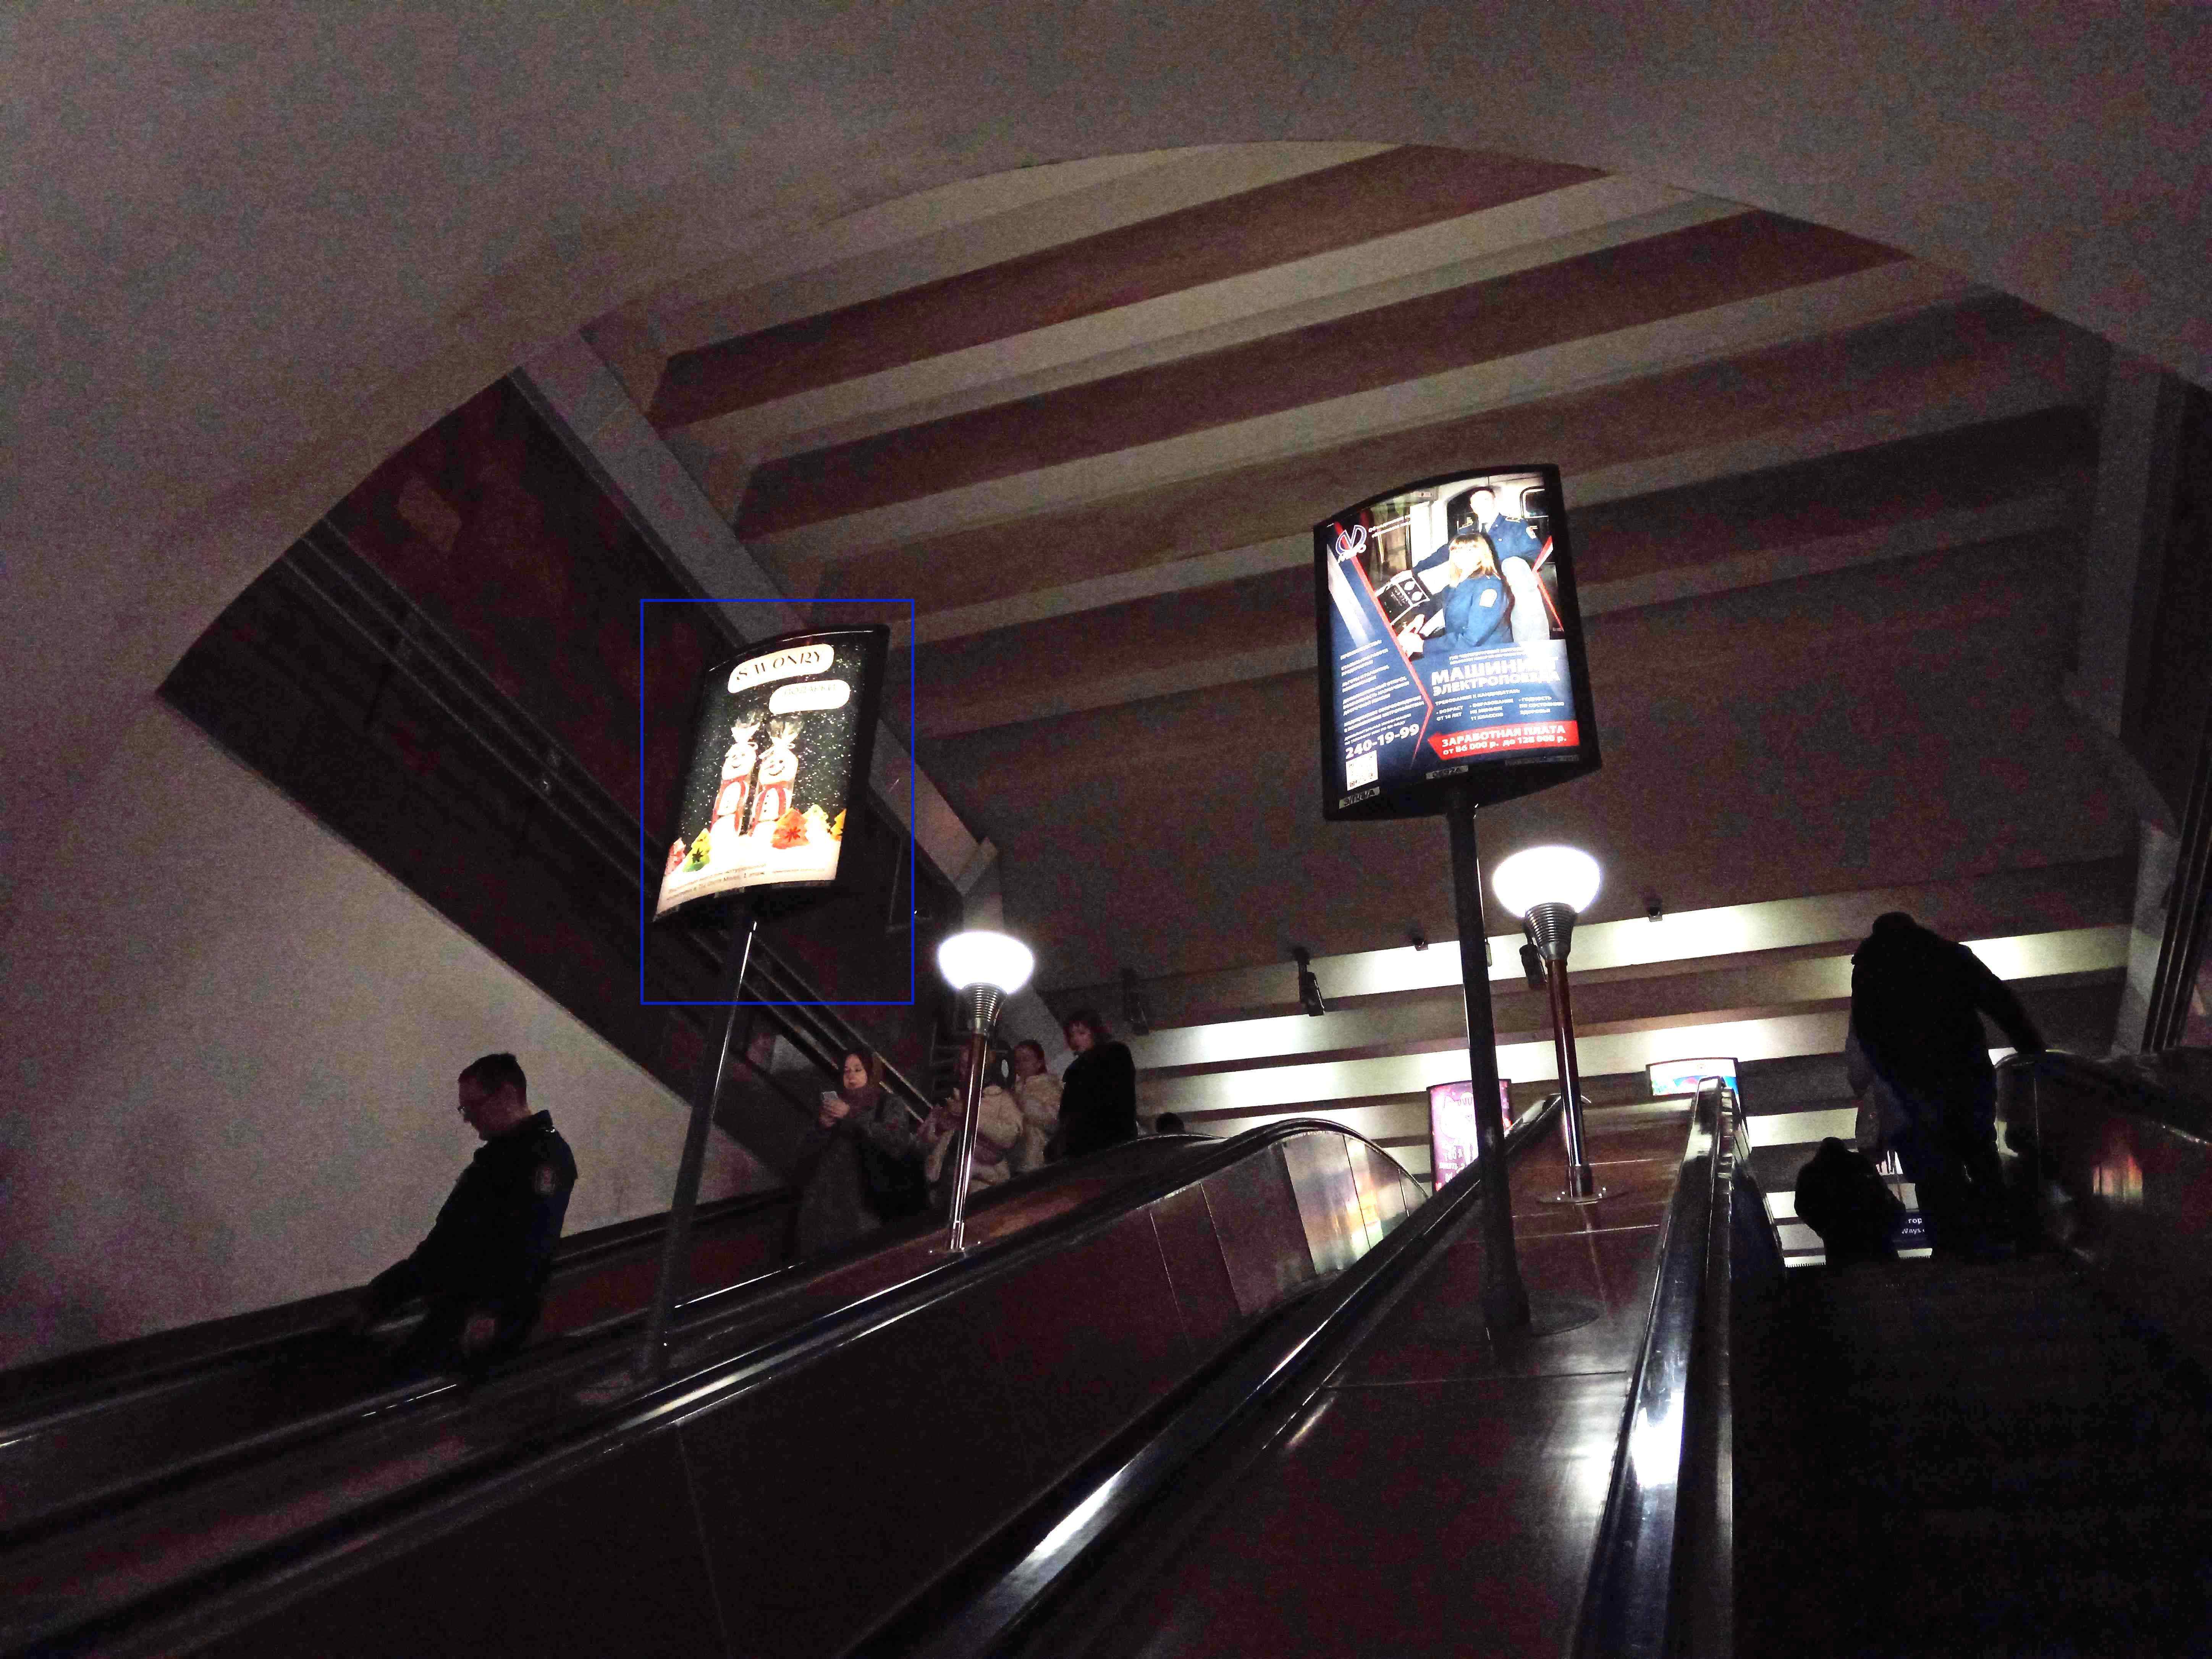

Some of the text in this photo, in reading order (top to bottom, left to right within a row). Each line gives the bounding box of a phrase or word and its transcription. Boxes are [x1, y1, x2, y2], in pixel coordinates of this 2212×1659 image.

[1431, 656, 1559, 685] МАШИНИТ
[1433, 671, 1561, 696] ЭЛЕКТРОПОЕДА
[1345, 724, 1420, 759] 240-19-99
[1442, 725, 1566, 747] ЗАРАБОТНАЯ ПЛАТА
[1469, 741, 1488, 750] 000
[1489, 741, 1499, 749] р.
